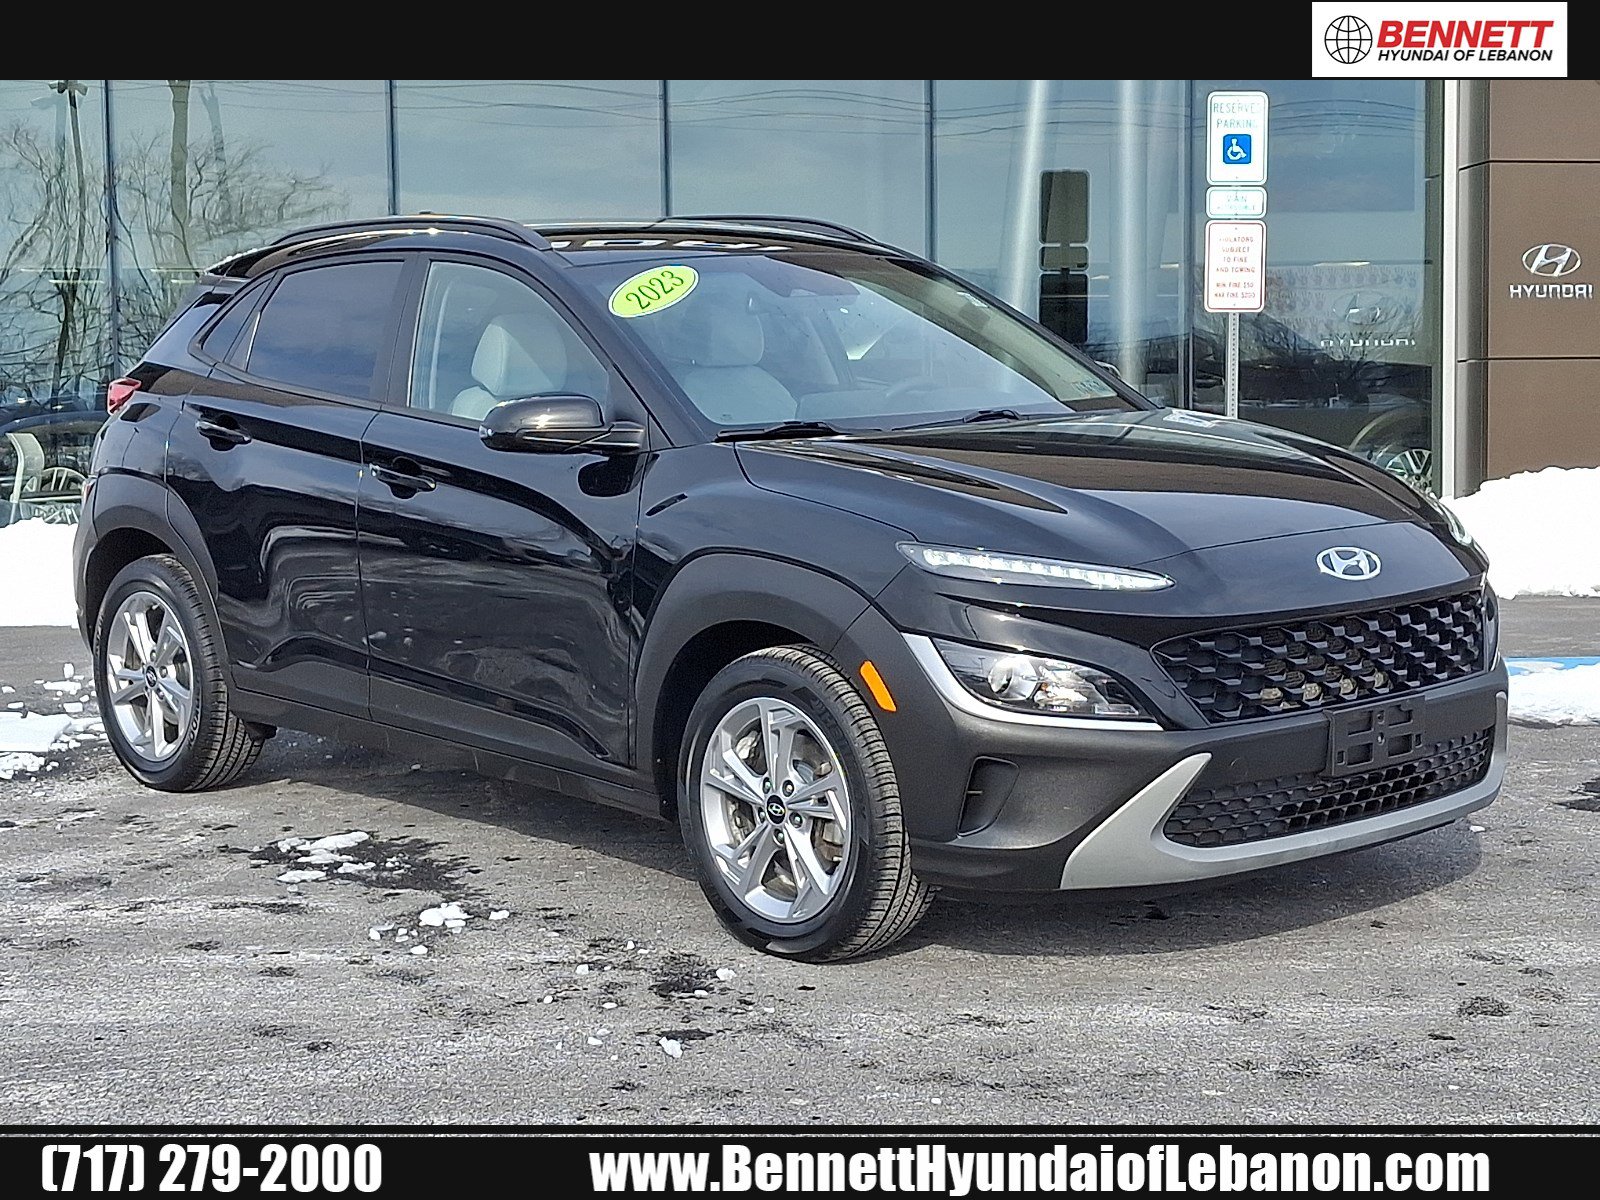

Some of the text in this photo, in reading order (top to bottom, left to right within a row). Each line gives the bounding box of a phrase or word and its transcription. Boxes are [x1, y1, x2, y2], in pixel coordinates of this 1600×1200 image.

[1213, 102, 1262, 114] RESERVE
[626, 270, 684, 310] 2023
[1509, 284, 1593, 299] HYUNDAI
